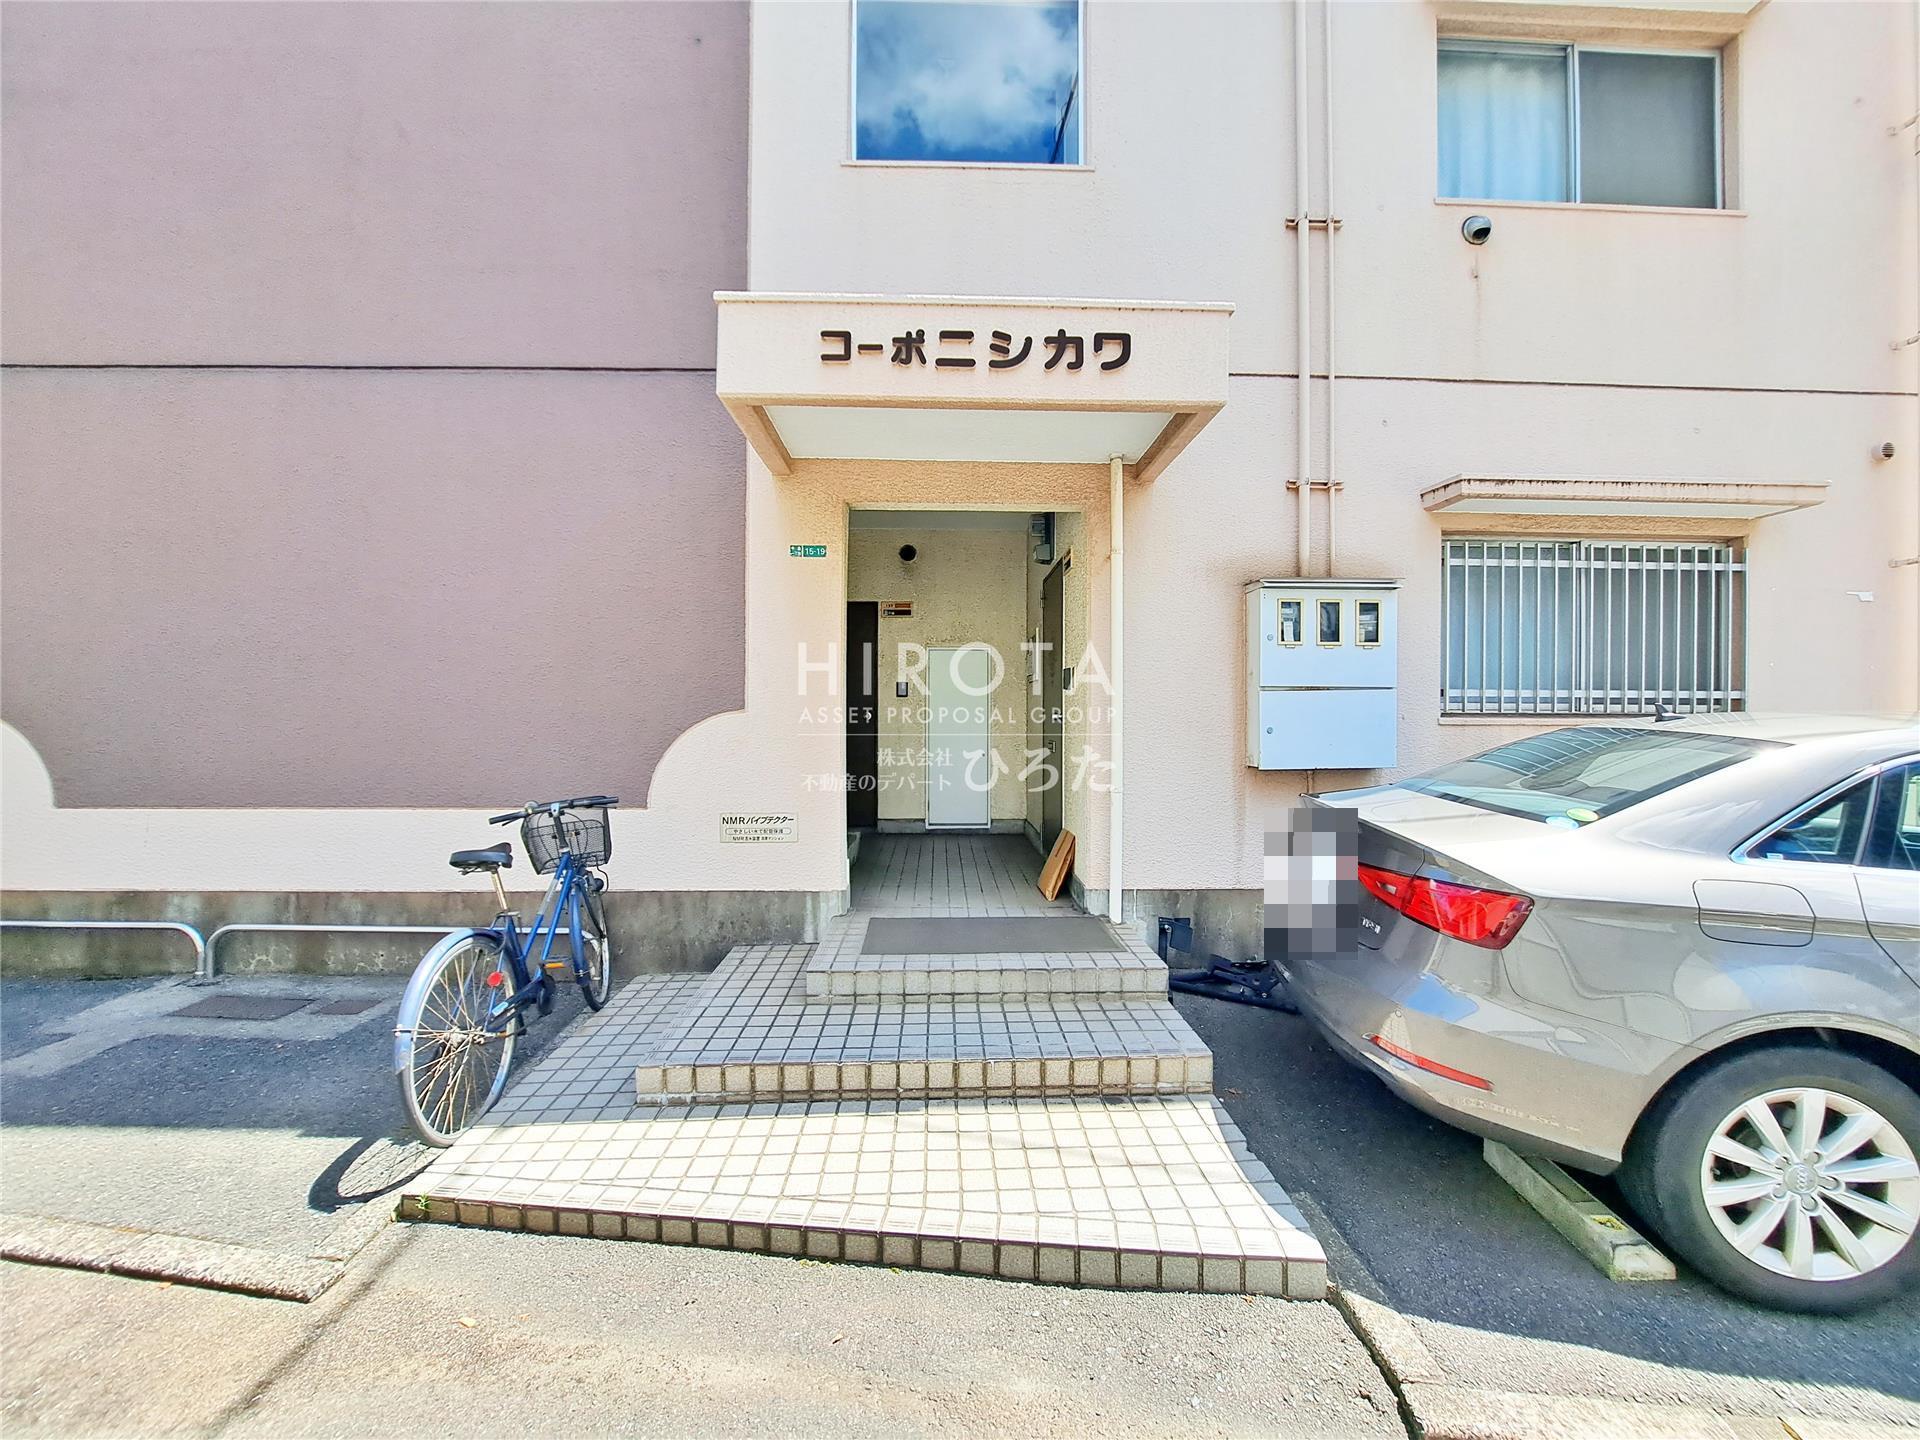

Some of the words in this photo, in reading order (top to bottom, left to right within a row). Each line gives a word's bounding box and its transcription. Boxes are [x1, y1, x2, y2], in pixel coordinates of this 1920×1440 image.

[820, 328, 1132, 371] コーポニシカワ
[805, 547, 825, 555] 15-19
